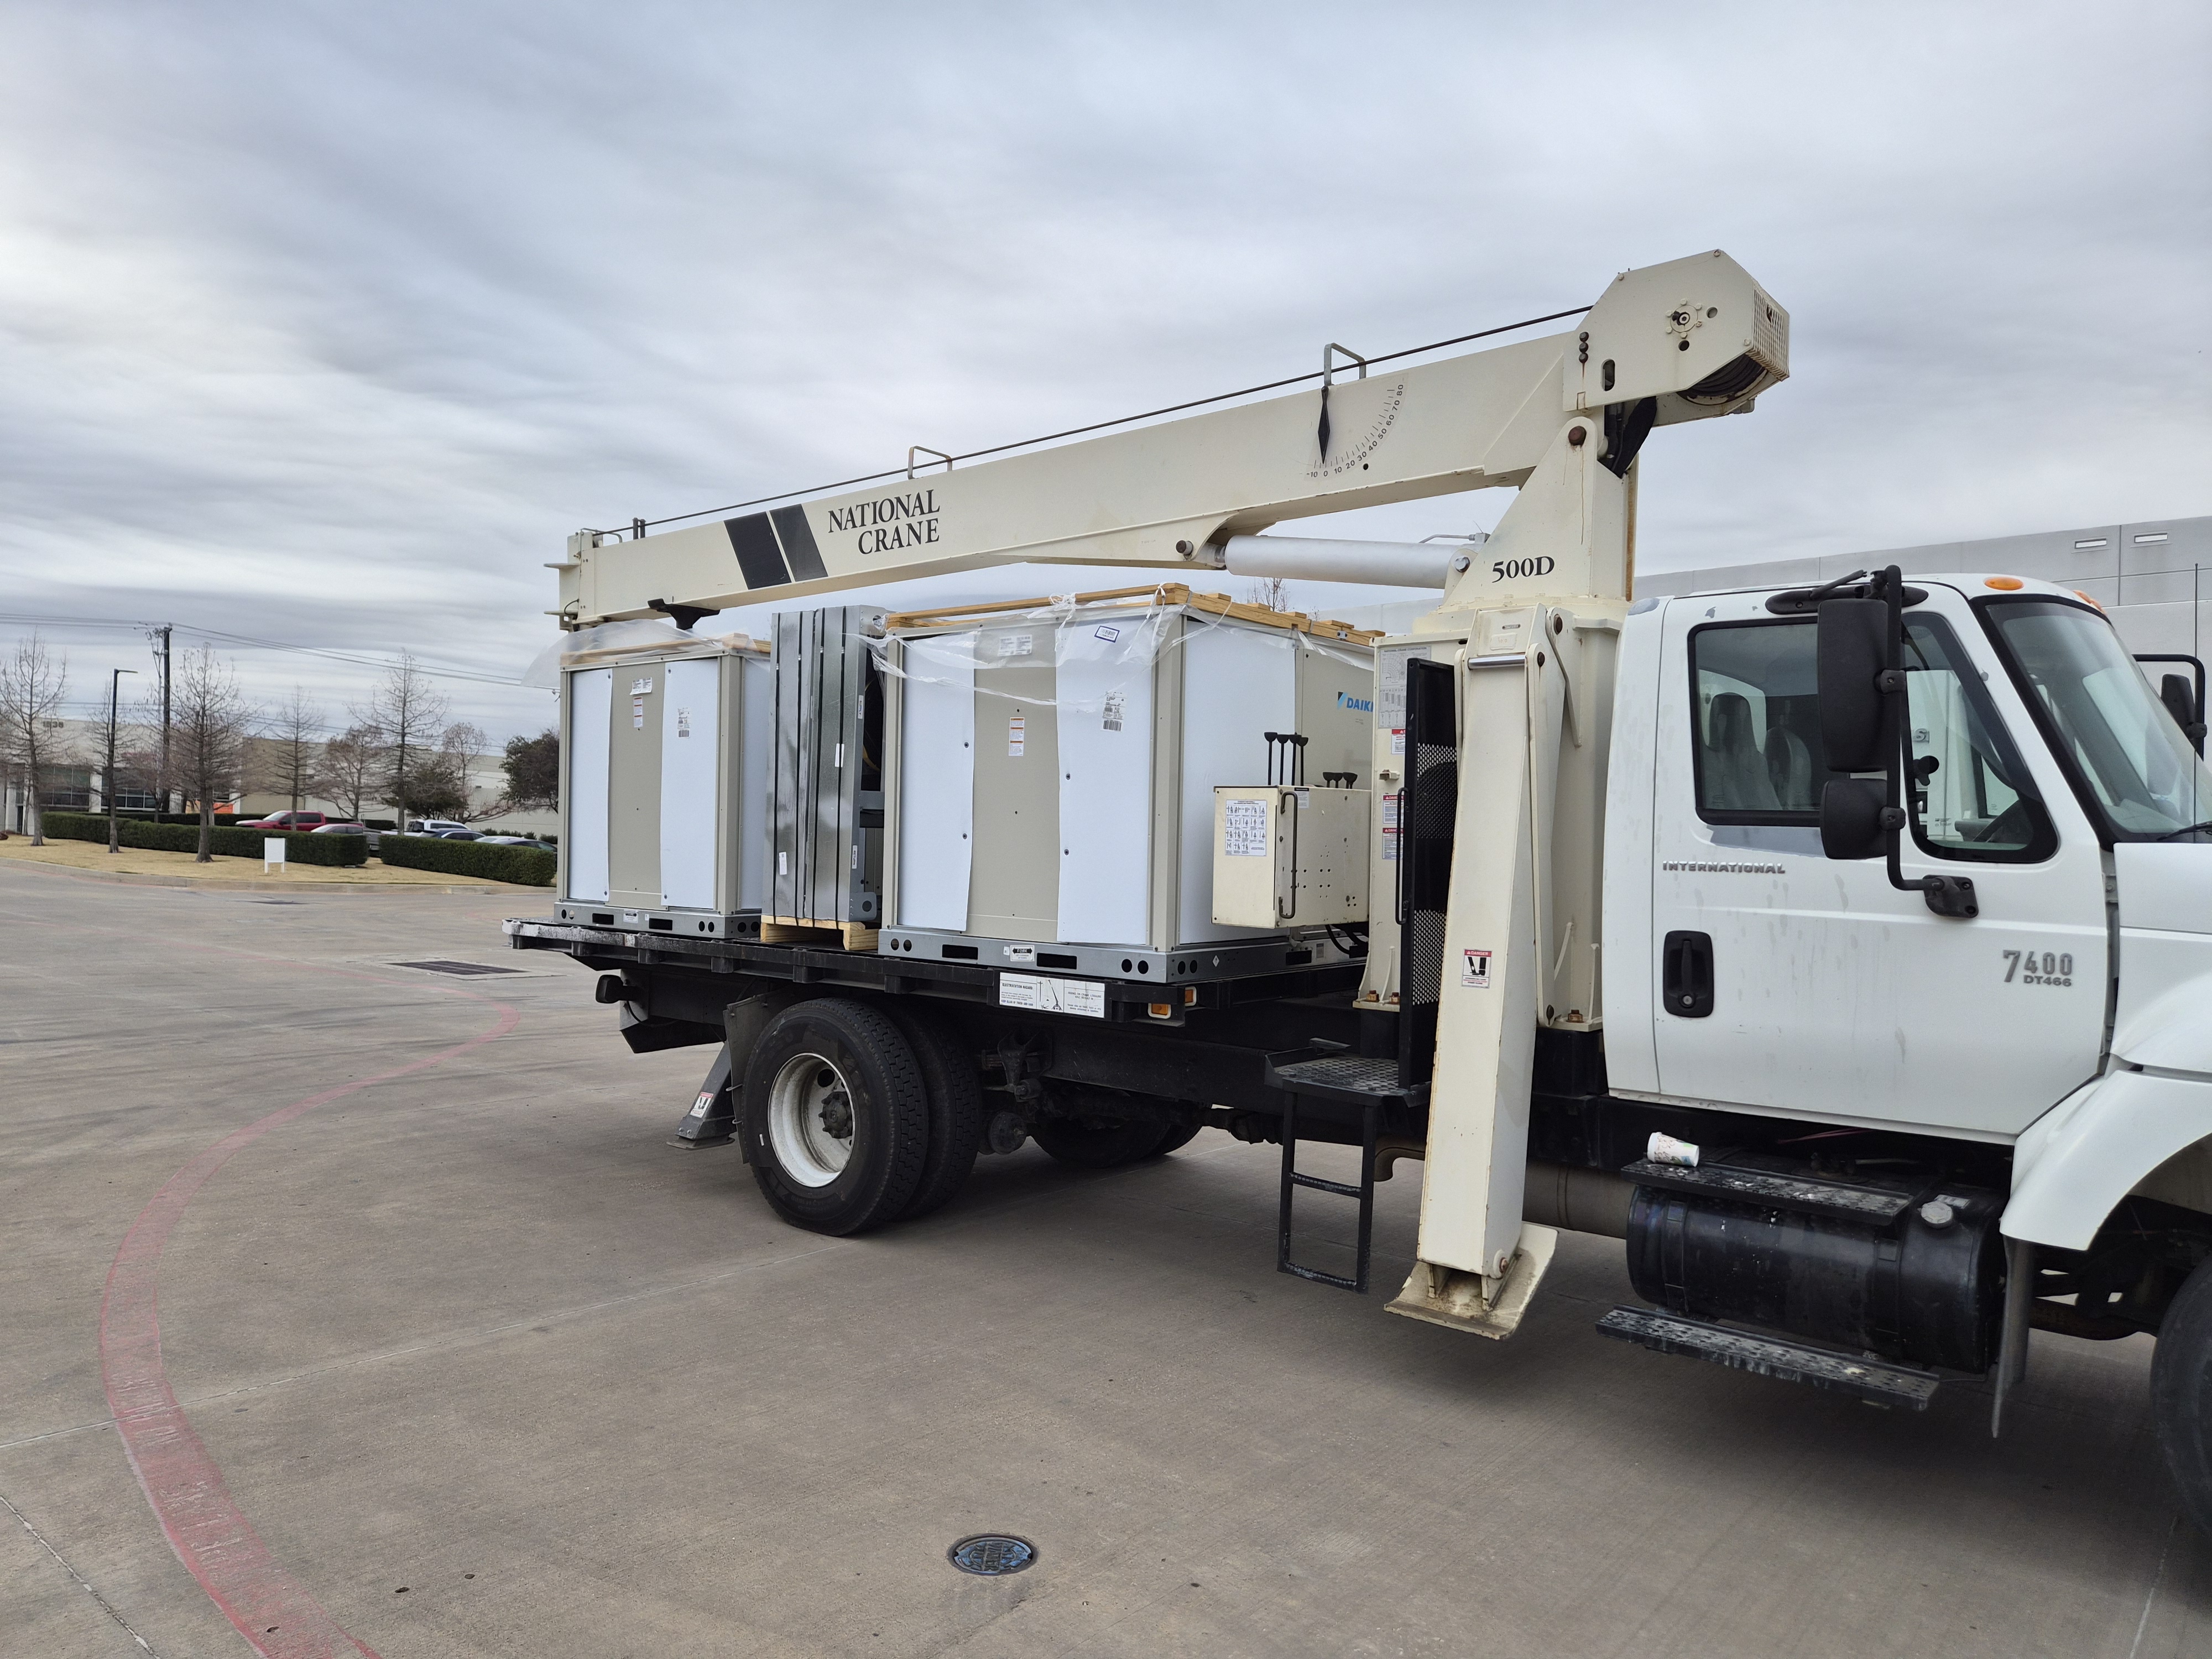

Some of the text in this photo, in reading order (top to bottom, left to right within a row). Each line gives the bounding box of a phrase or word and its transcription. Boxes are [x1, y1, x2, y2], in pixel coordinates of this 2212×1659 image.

[1345, 460, 1355, 469] 20
[1357, 451, 1367, 461] 30
[1369, 440, 1378, 451] 40
[1378, 428, 1387, 439] 50
[1386, 414, 1395, 426] 60
[1392, 400, 1400, 411] 70
[1396, 384, 1404, 396] 80
[828, 489, 940, 533] NATIONAL
[858, 518, 940, 555] CRANE
[1491, 556, 1554, 583] 500D
[1347, 697, 1374, 713] DAIKI
[1662, 860, 1786, 874] INTERNATIONAL
[2002, 950, 2073, 983] 7400
[2023, 975, 2072, 987] DT466
